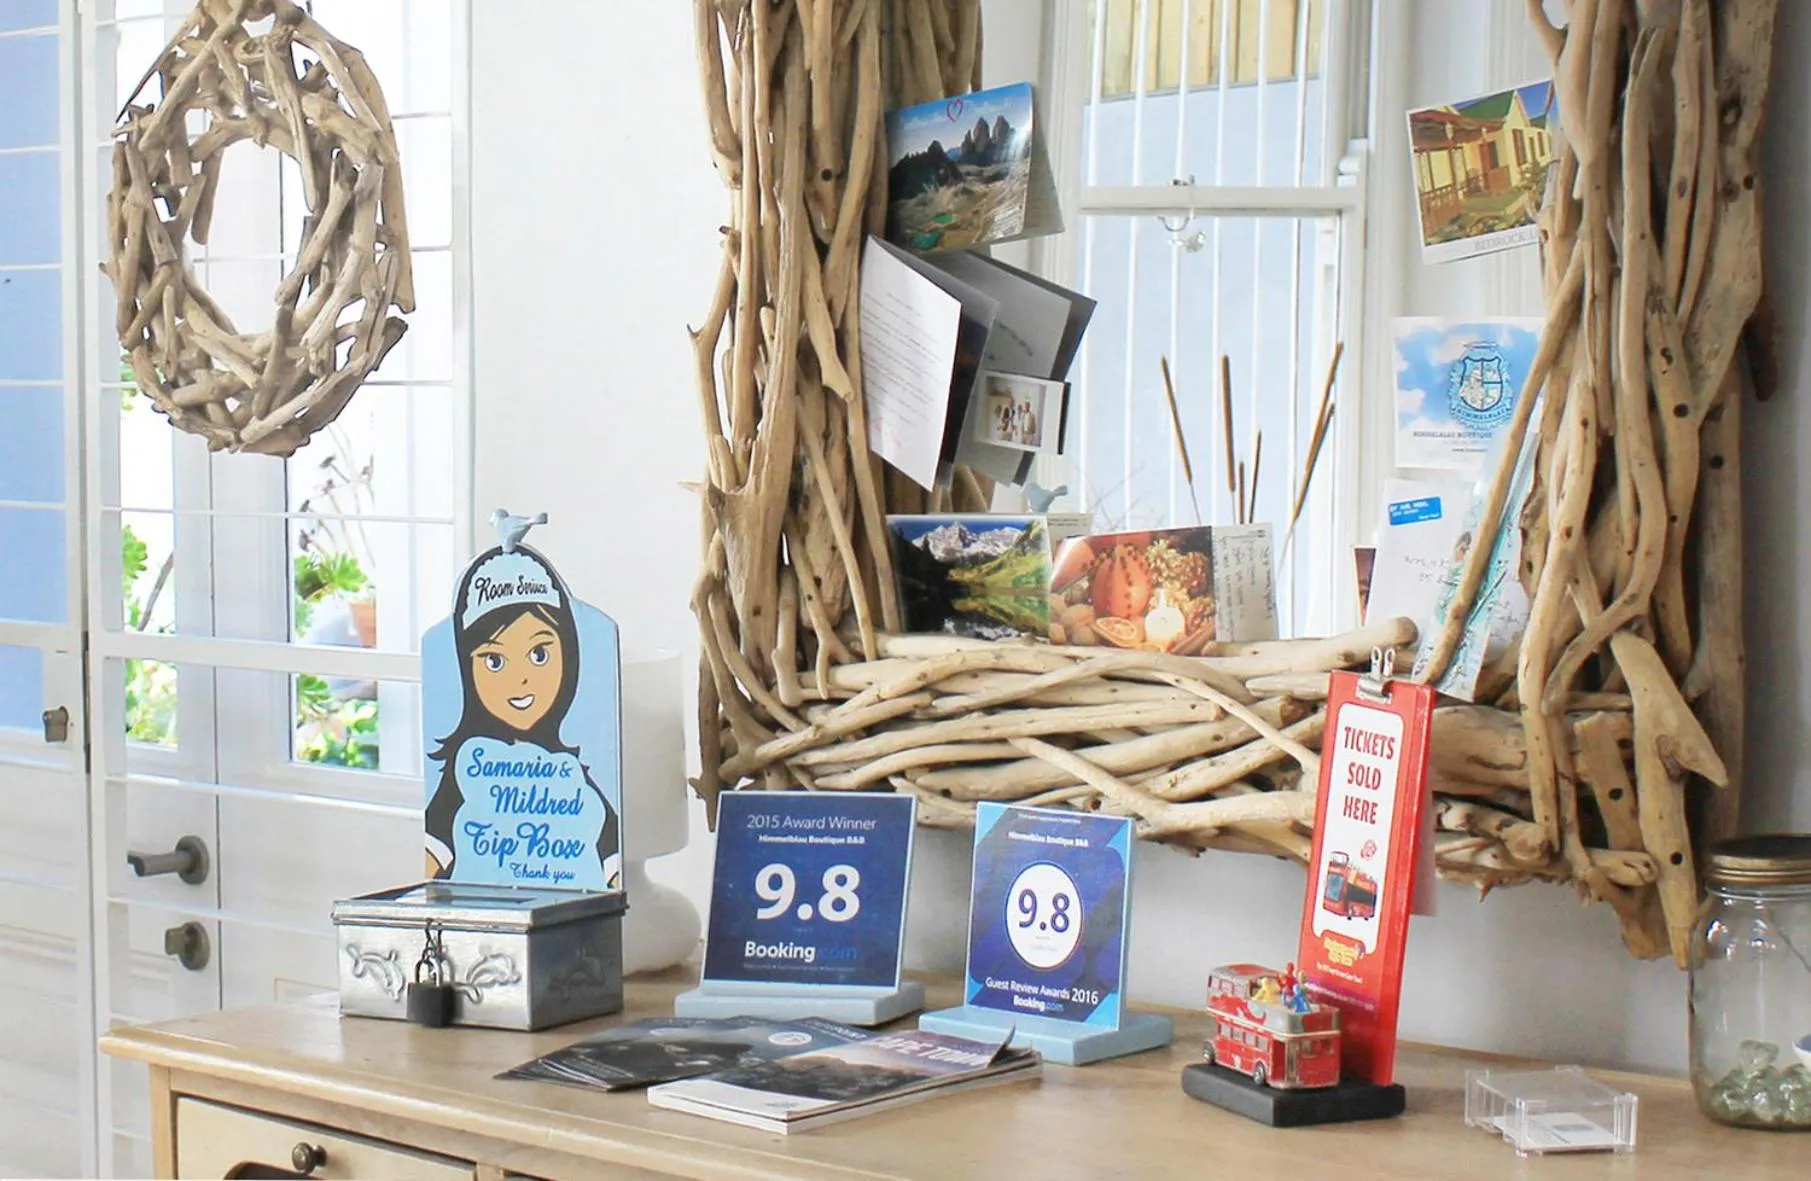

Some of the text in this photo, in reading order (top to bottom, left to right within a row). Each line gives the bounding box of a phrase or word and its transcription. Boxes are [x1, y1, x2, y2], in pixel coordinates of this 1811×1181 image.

[475, 576, 515, 606] Room
[1344, 725, 1396, 760] TICKETS
[466, 747, 573, 778] Samaria &
[1347, 761, 1382, 791] SOLD
[489, 784, 583, 815] Mildred
[1343, 794, 1379, 825] HERE
[746, 814, 877, 830] 2015 Award Winner
[464, 821, 585, 868] Tip Box
[510, 862, 576, 884] Thank you
[755, 863, 861, 923] 9.8
[1018, 888, 1071, 933] 9.8
[985, 976, 1100, 1006] Guest Review Awards 2016
